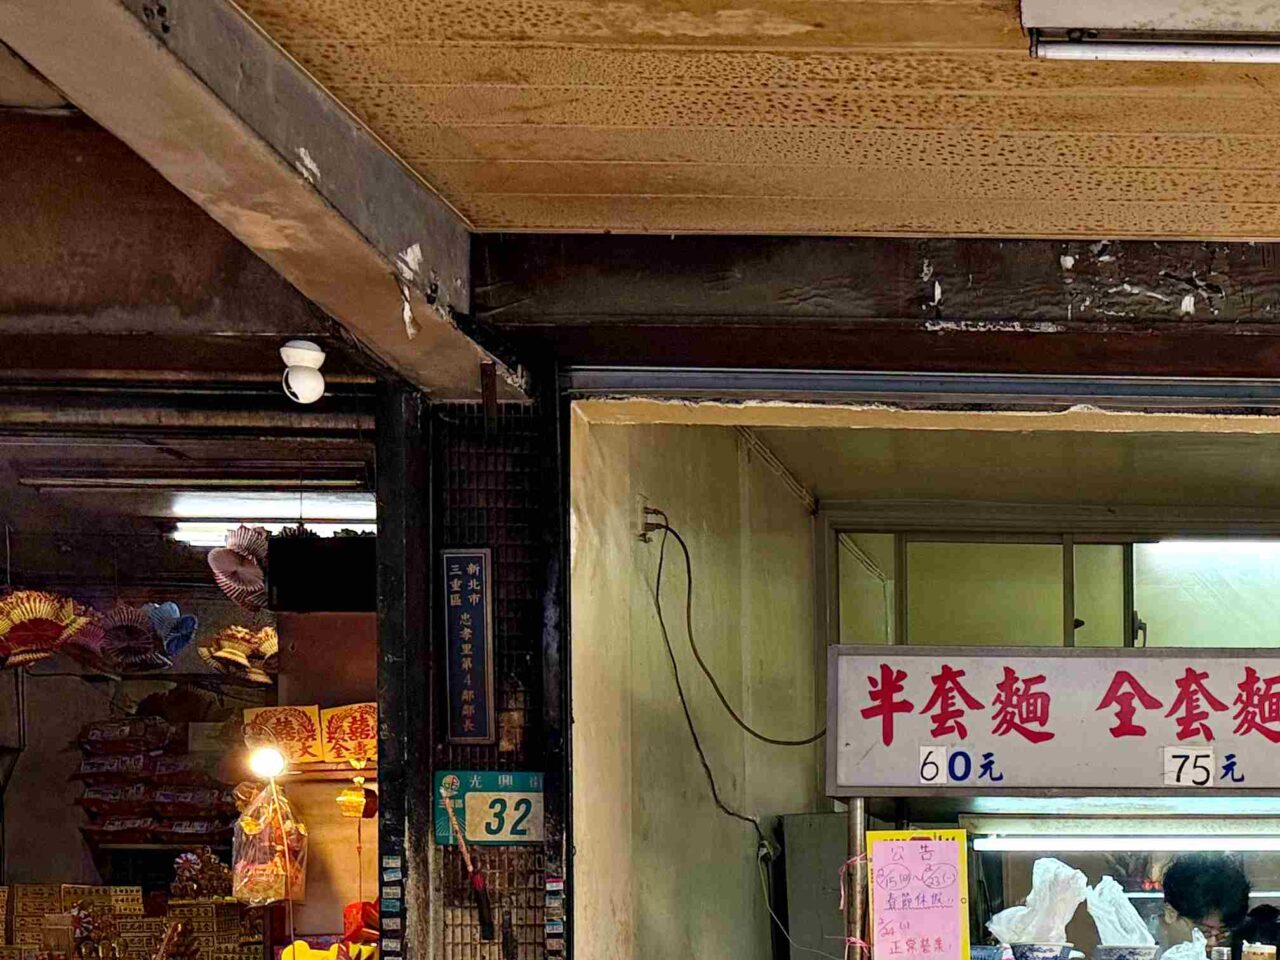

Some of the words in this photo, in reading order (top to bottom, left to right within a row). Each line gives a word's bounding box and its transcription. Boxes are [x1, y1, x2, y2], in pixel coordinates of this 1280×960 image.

[860, 664, 1055, 746] 半套麵
[470, 775, 543, 788] 光興街
[920, 751, 1003, 782] 60元
[1171, 754, 1244, 785] 75元
[485, 798, 532, 835] 32
[891, 844, 935, 861] 公告
